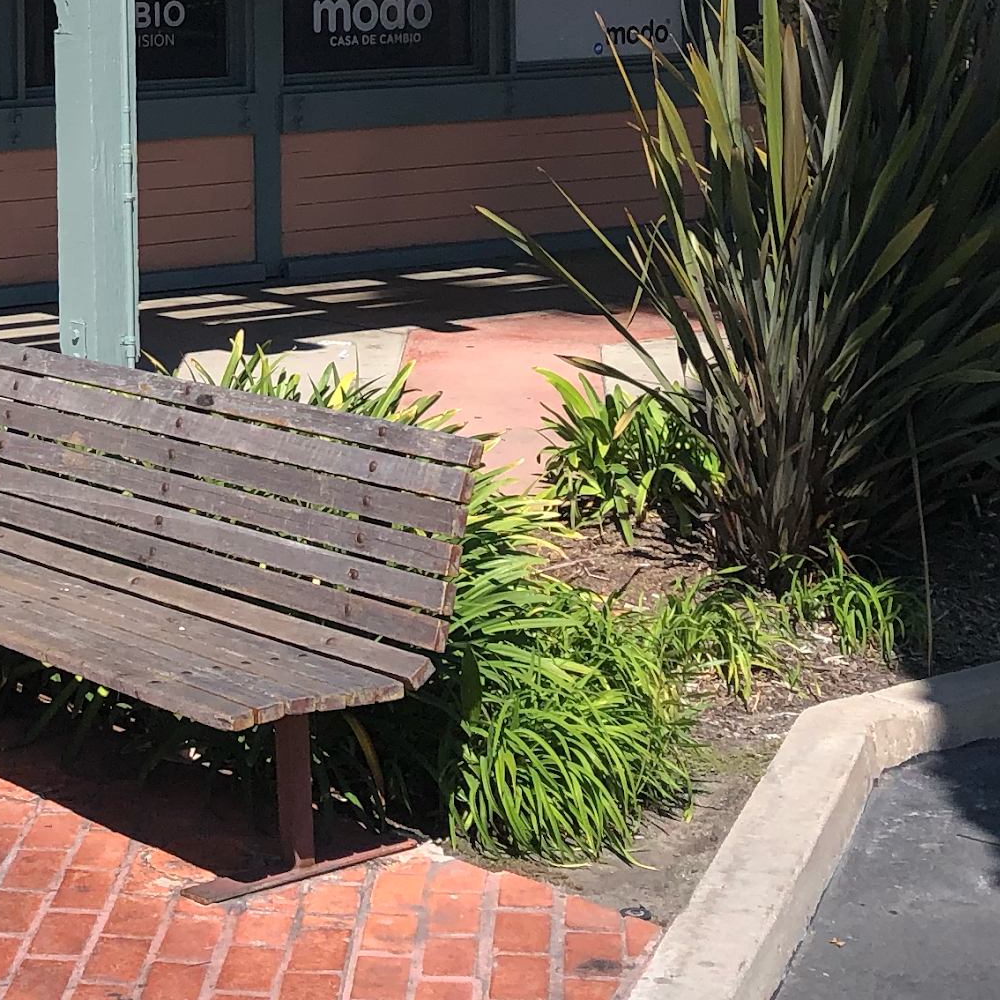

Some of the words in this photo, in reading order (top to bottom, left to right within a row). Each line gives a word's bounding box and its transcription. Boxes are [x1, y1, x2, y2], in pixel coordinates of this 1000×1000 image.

[329, 35, 360, 47] CASA
[361, 34, 377, 46] DE
[379, 32, 422, 45] CAMBIO
[606, 19, 668, 46] modo
